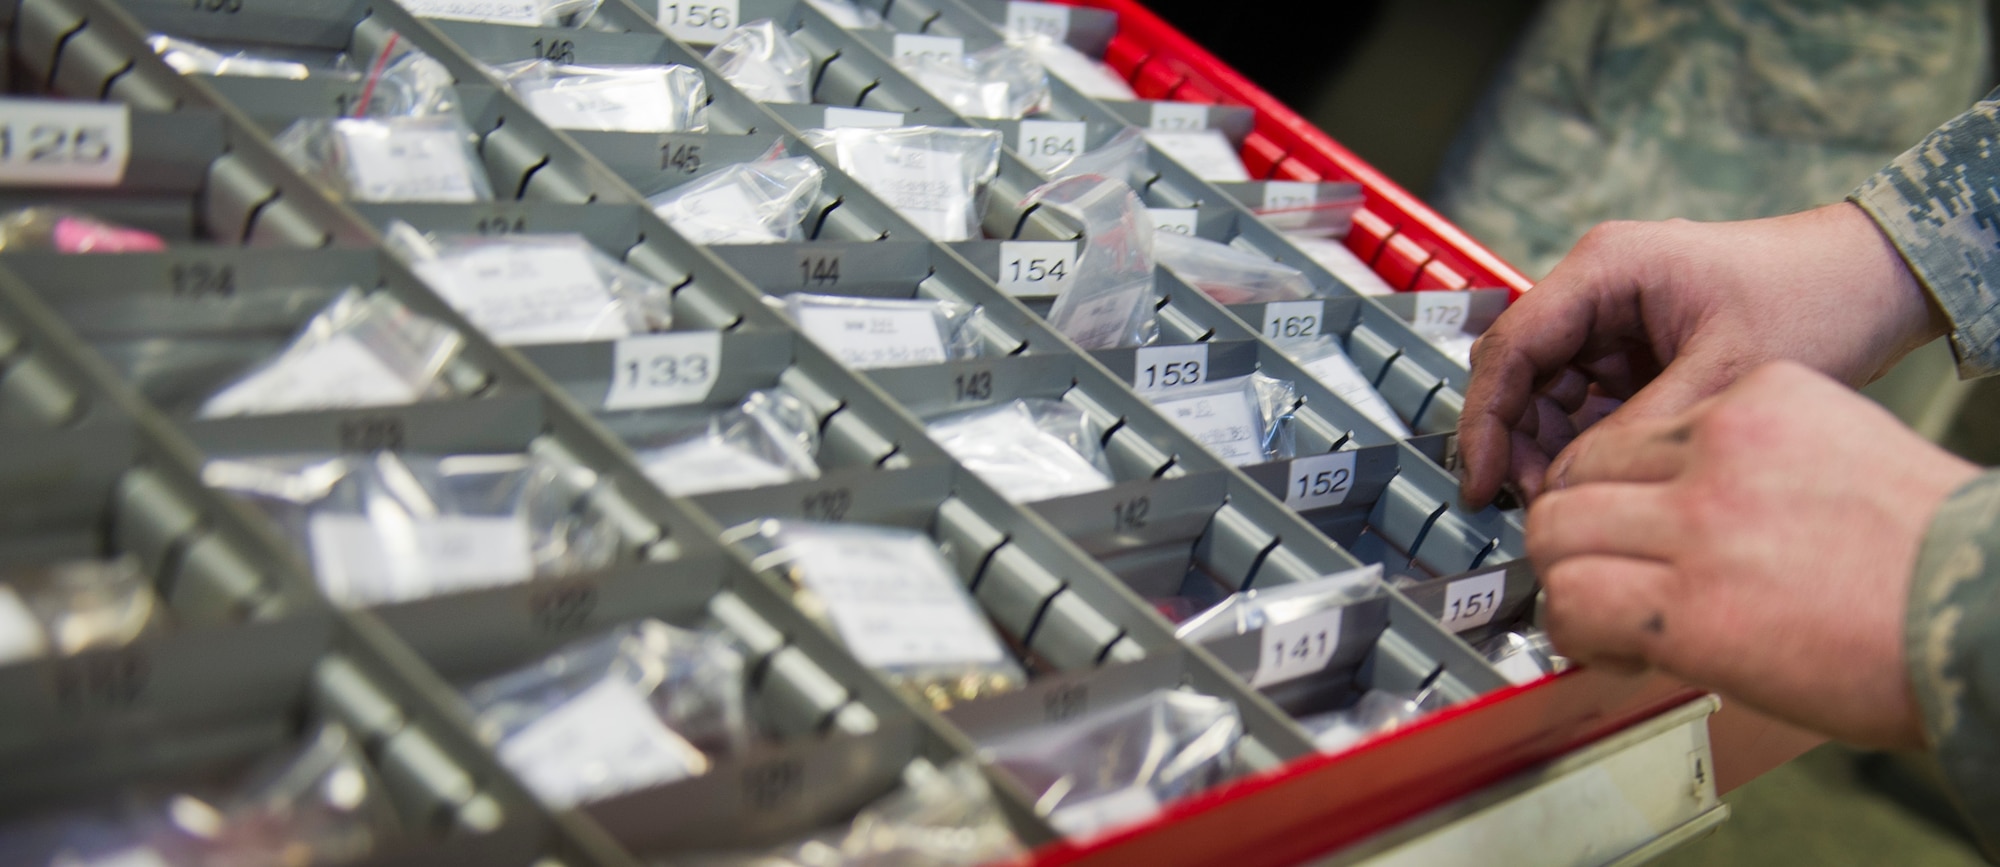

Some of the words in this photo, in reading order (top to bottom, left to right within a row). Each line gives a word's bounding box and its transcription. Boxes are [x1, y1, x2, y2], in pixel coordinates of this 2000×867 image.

[668, 4, 730, 30] 156
[532, 38, 575, 65] 146
[0, 124, 111, 164] 125
[660, 142, 702, 174] 145
[1027, 137, 1076, 158] 164
[800, 257, 841, 286] 144
[1009, 258, 1069, 283] 154
[1271, 315, 1316, 338] 162
[1424, 305, 1462, 325] 172
[626, 355, 709, 389] 133
[954, 371, 993, 400] 143
[1145, 361, 1201, 388] 153
[1297, 468, 1350, 498] 152
[1111, 496, 1150, 532] 142
[1449, 589, 1498, 620] 151
[1270, 629, 1329, 669] 141
